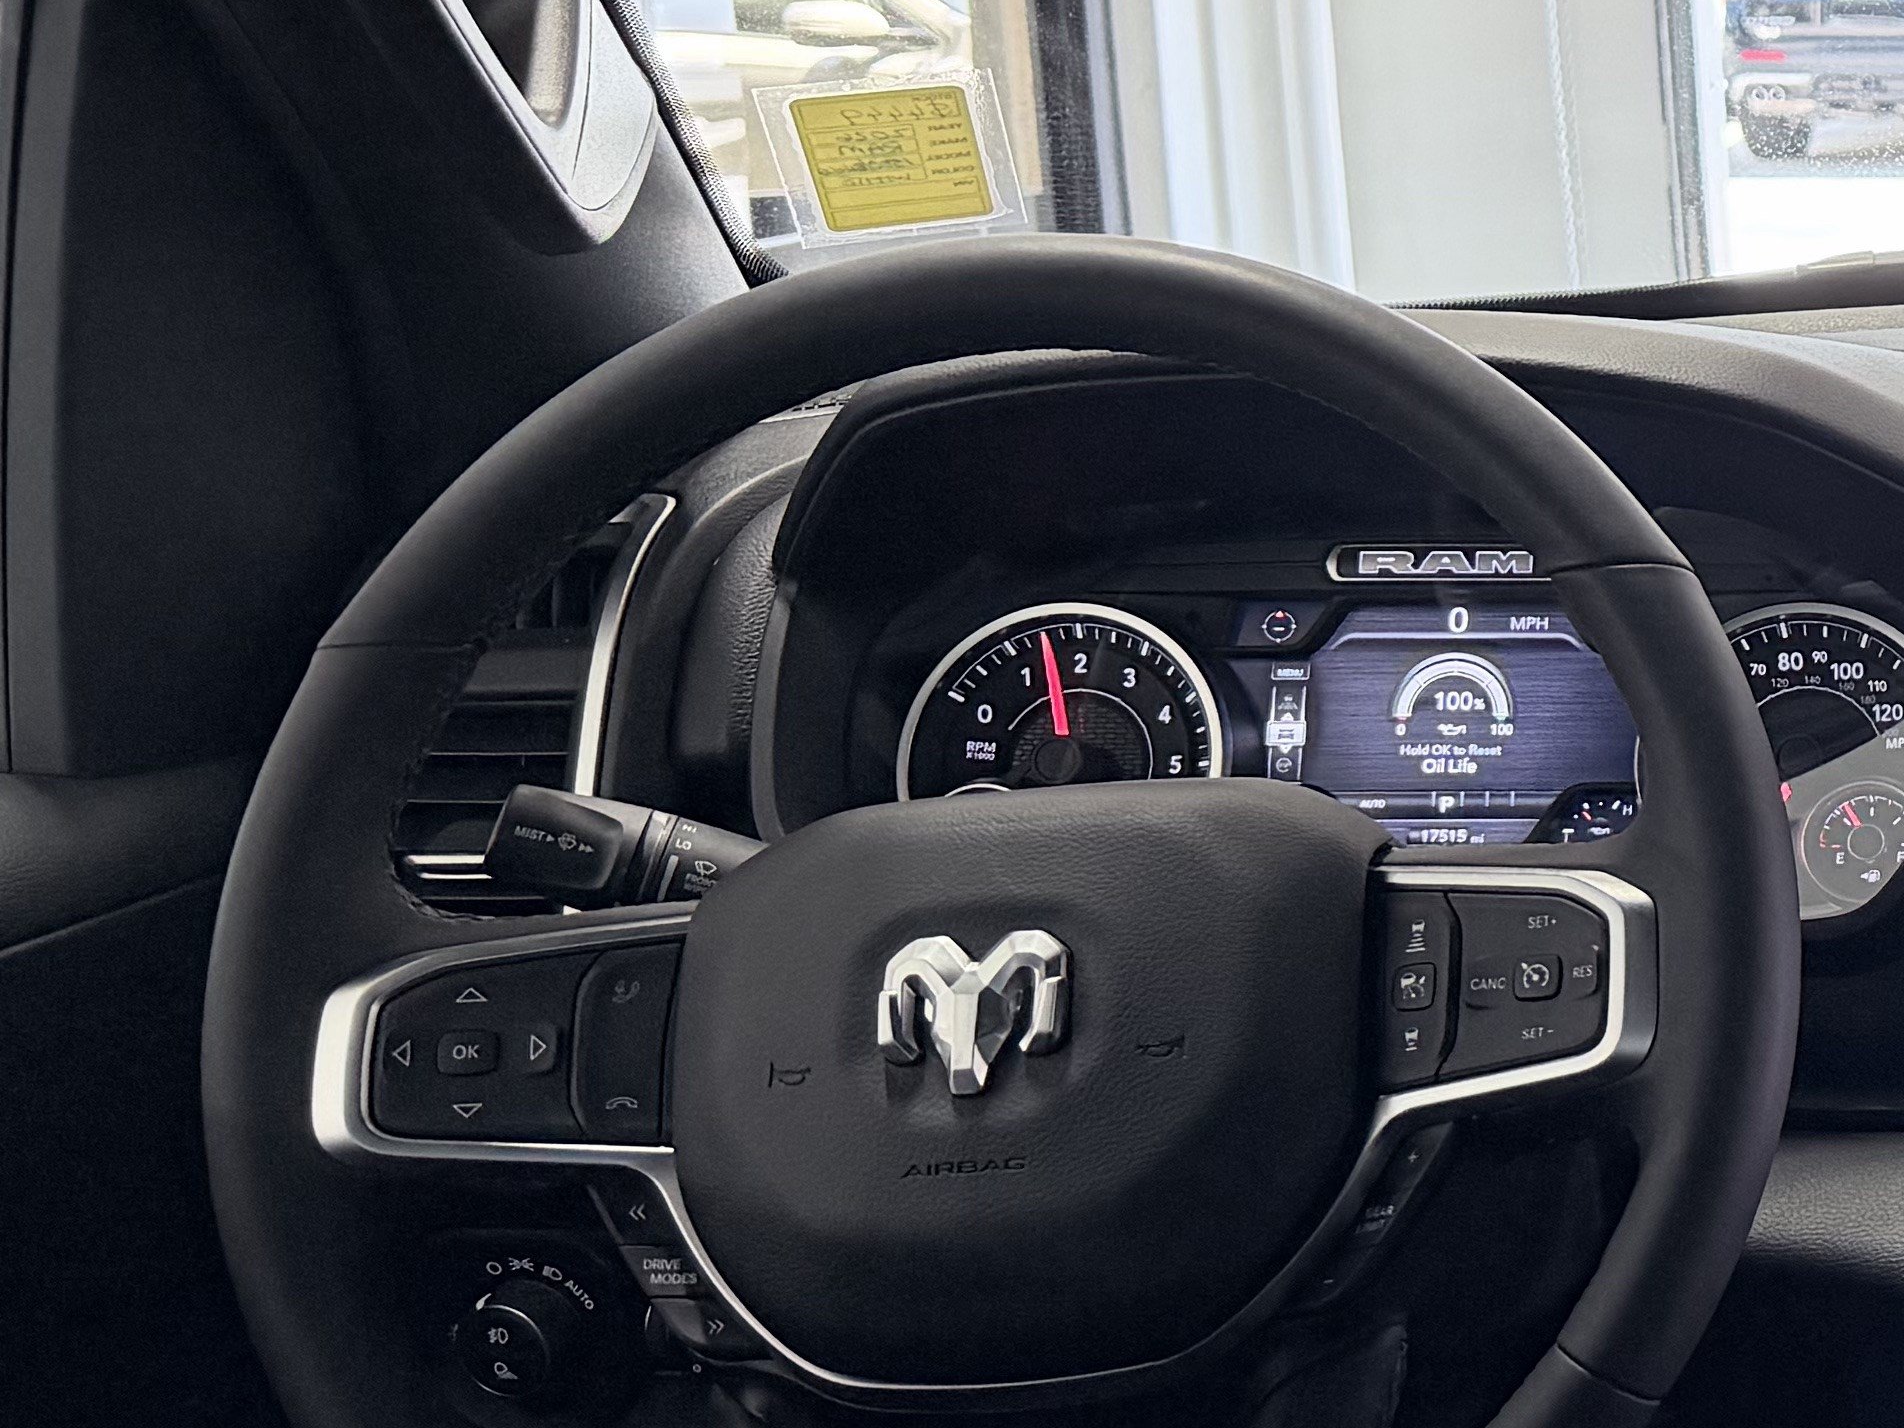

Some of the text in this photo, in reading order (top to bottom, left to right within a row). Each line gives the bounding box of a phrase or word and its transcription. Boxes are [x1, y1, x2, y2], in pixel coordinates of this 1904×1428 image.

[1358, 550, 1534, 574] RAM
[1448, 606, 1469, 634] 0
[1509, 617, 1549, 632] MPH
[1073, 653, 1088, 674] 2
[1777, 652, 1804, 671] 80
[1811, 651, 1828, 663] 90
[1021, 668, 1031, 687] 1
[1122, 668, 1136, 688] 3
[1750, 663, 1767, 676] 70
[1830, 662, 1864, 681] 100
[1867, 680, 1888, 693] 110
[1434, 691, 1486, 711] 100%
[977, 704, 993, 724] 0
[1158, 705, 1172, 725] 4
[1872, 703, 1904, 723] 120
[1490, 723, 1514, 736] 100
[966, 740, 997, 753] RPM
[1399, 744, 1502, 757] Hold OK to Reset
[1169, 755, 1183, 774] 5
[1421, 758, 1478, 774] Oil Life
[1439, 795, 1454, 813] P
[515, 825, 547, 842] MIST
[1835, 852, 1845, 865] E
[1572, 964, 1594, 978] RES
[1470, 976, 1507, 991] CANC
[452, 1044, 480, 1061] OK
[901, 1156, 1028, 1179] AIRBAG
[643, 1258, 682, 1271] DRIVE
[650, 1272, 698, 1285] MODES
[564, 1279, 595, 1310] AUTO
